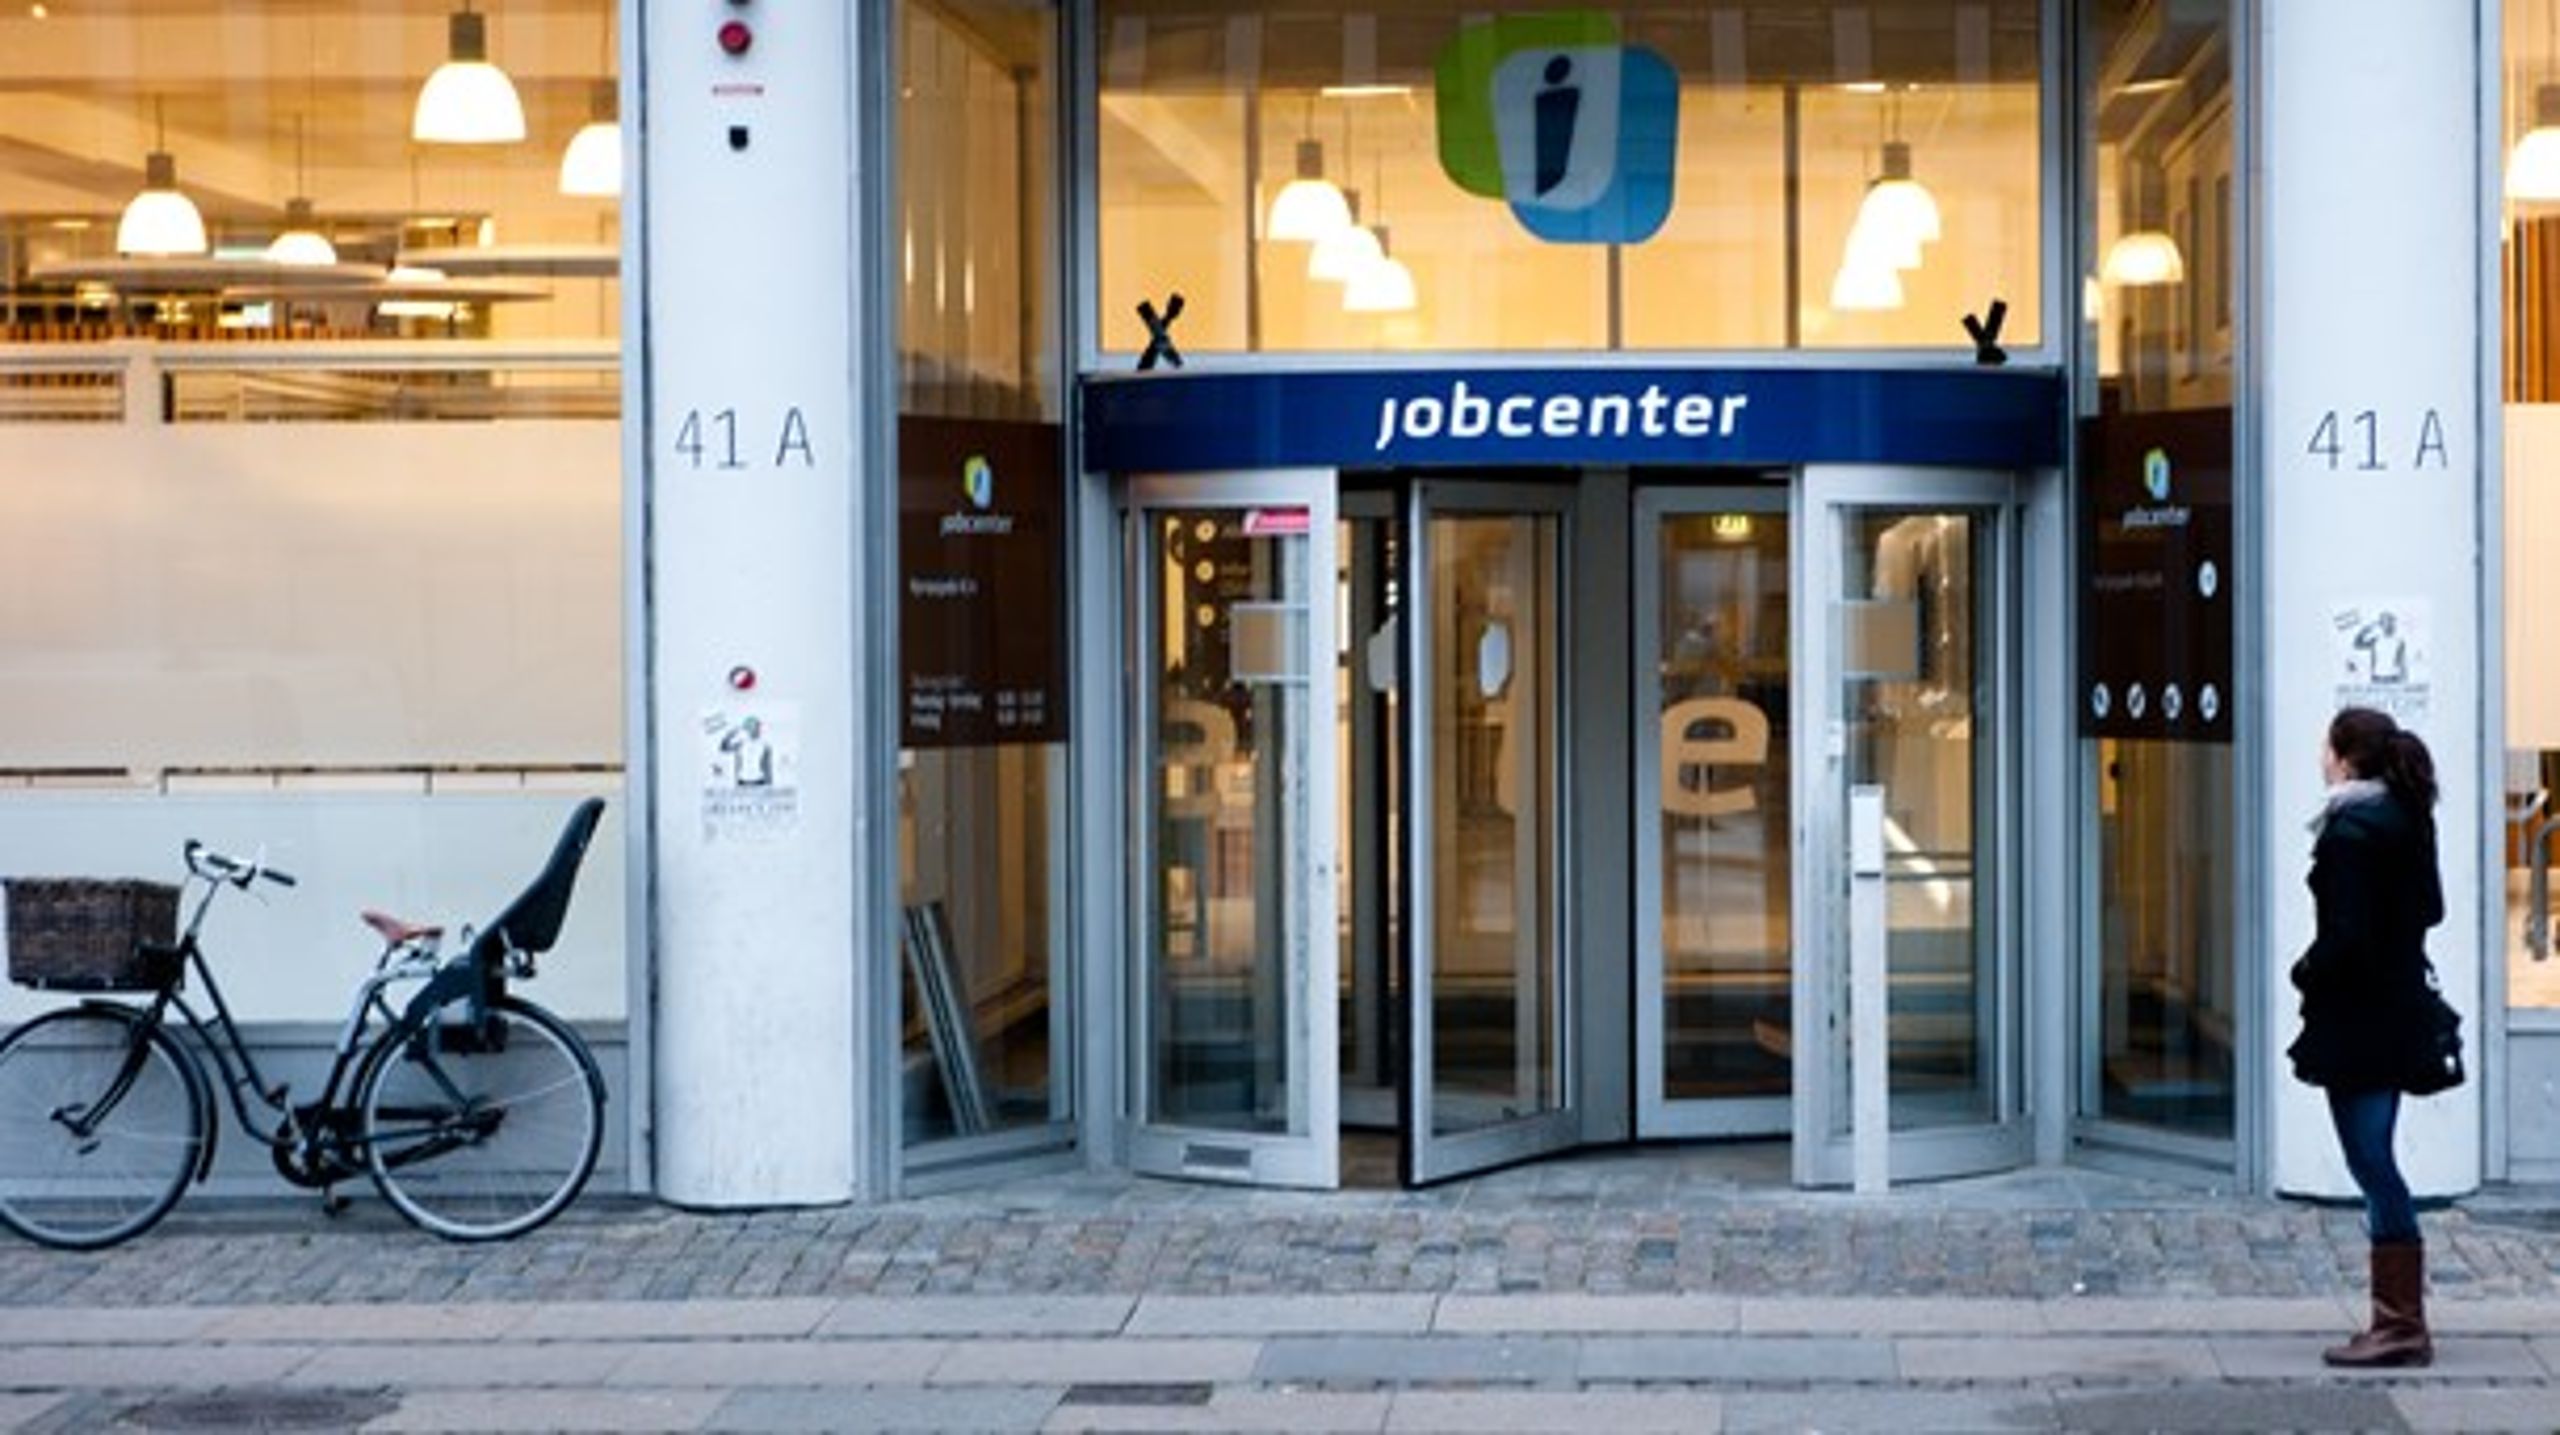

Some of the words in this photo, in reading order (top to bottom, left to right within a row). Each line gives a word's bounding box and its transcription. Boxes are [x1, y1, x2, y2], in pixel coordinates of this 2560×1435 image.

[675, 408, 750, 469] 41
[775, 406, 815, 467] A
[1376, 380, 1748, 450] jobcenter
[2307, 410, 2388, 470] 41
[2413, 409, 2449, 470] A
